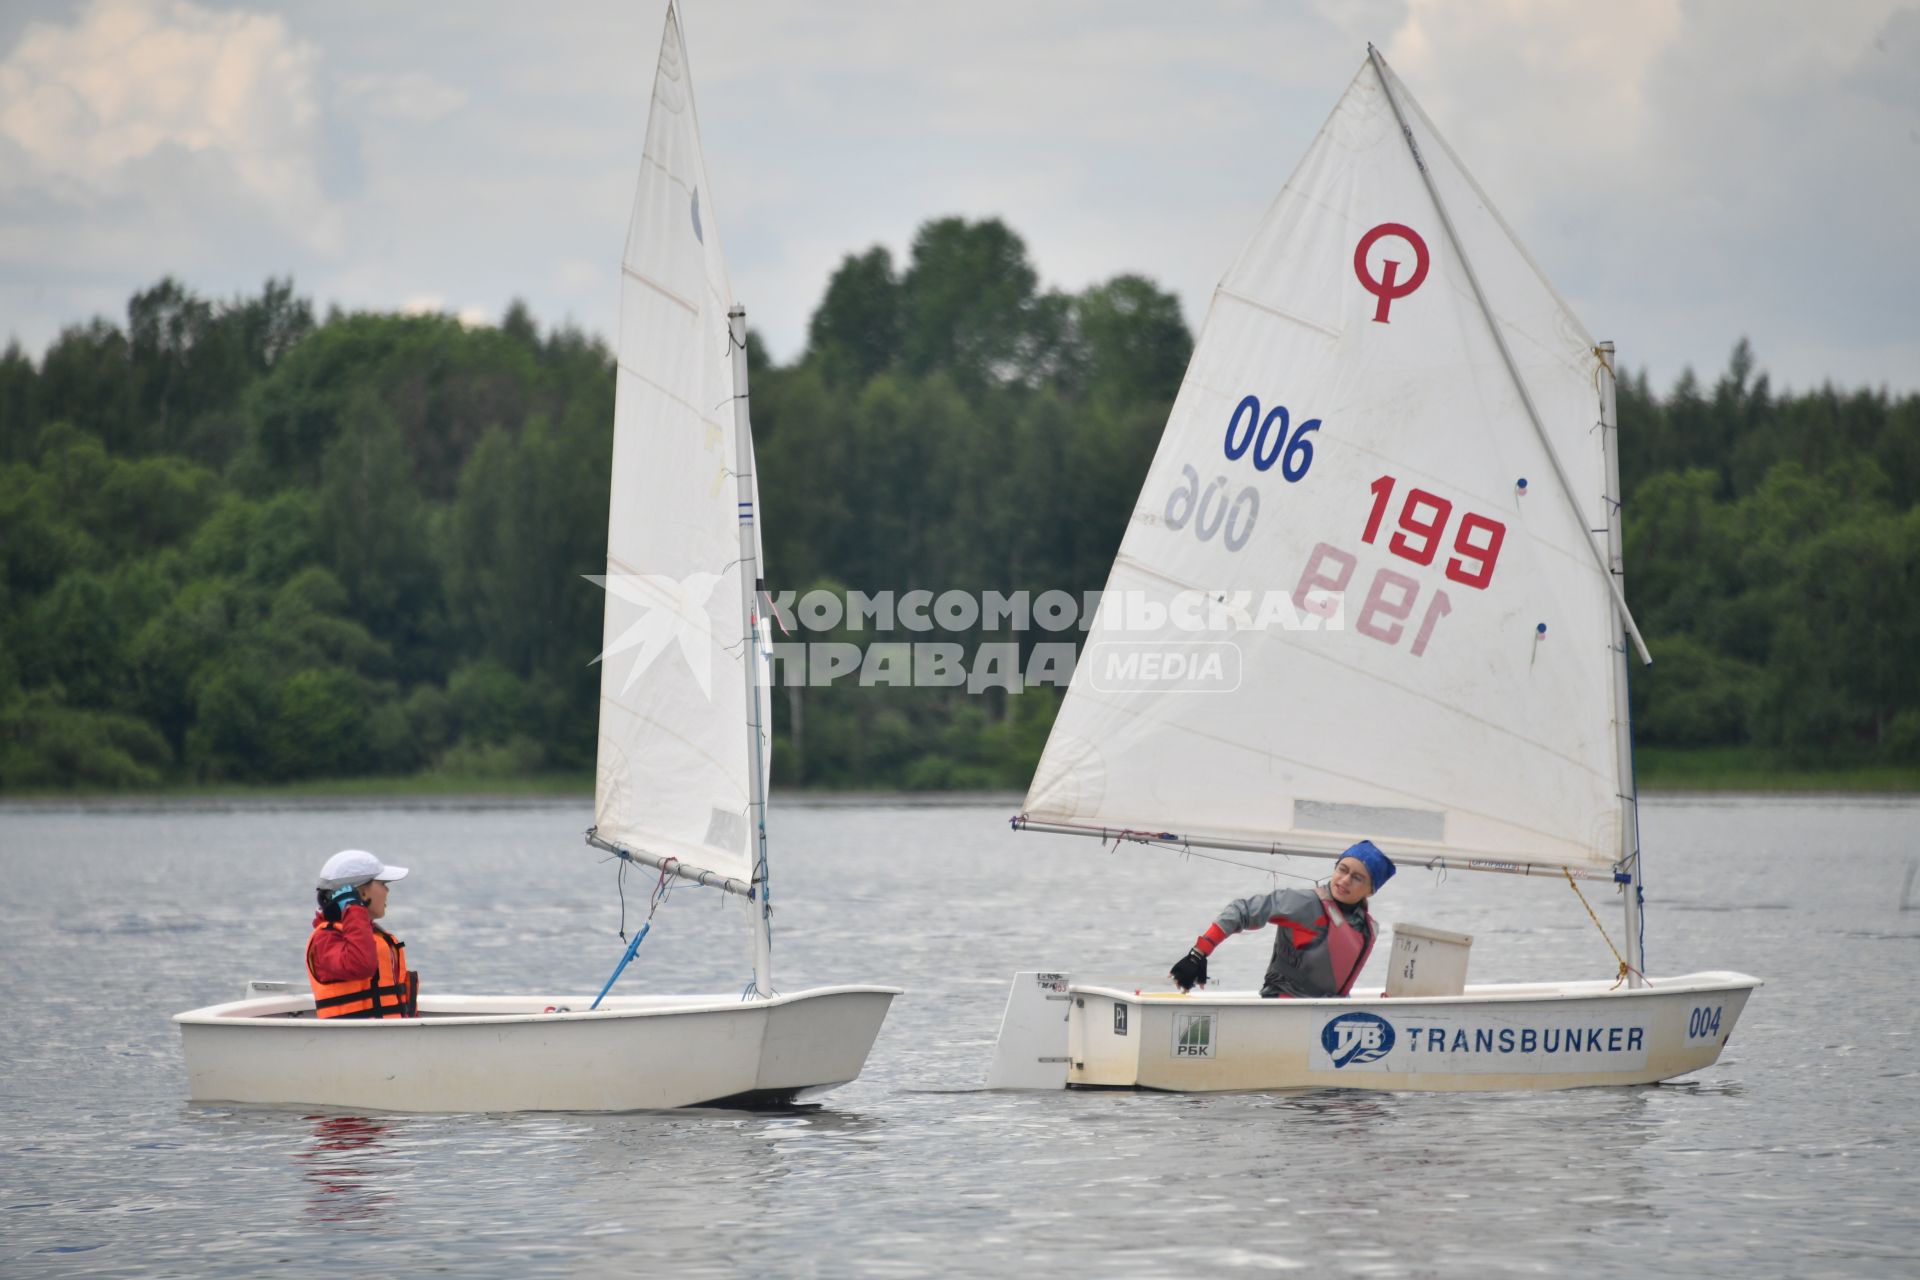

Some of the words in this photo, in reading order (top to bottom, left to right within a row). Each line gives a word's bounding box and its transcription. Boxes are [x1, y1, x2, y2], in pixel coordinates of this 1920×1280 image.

[1224, 394, 1322, 483] 006
[1361, 475, 1507, 590] 199
[1689, 1006, 1722, 1038] 004
[1177, 1045, 1208, 1056] РБК
[1406, 1027, 1644, 1053] TRANSBUNKER
